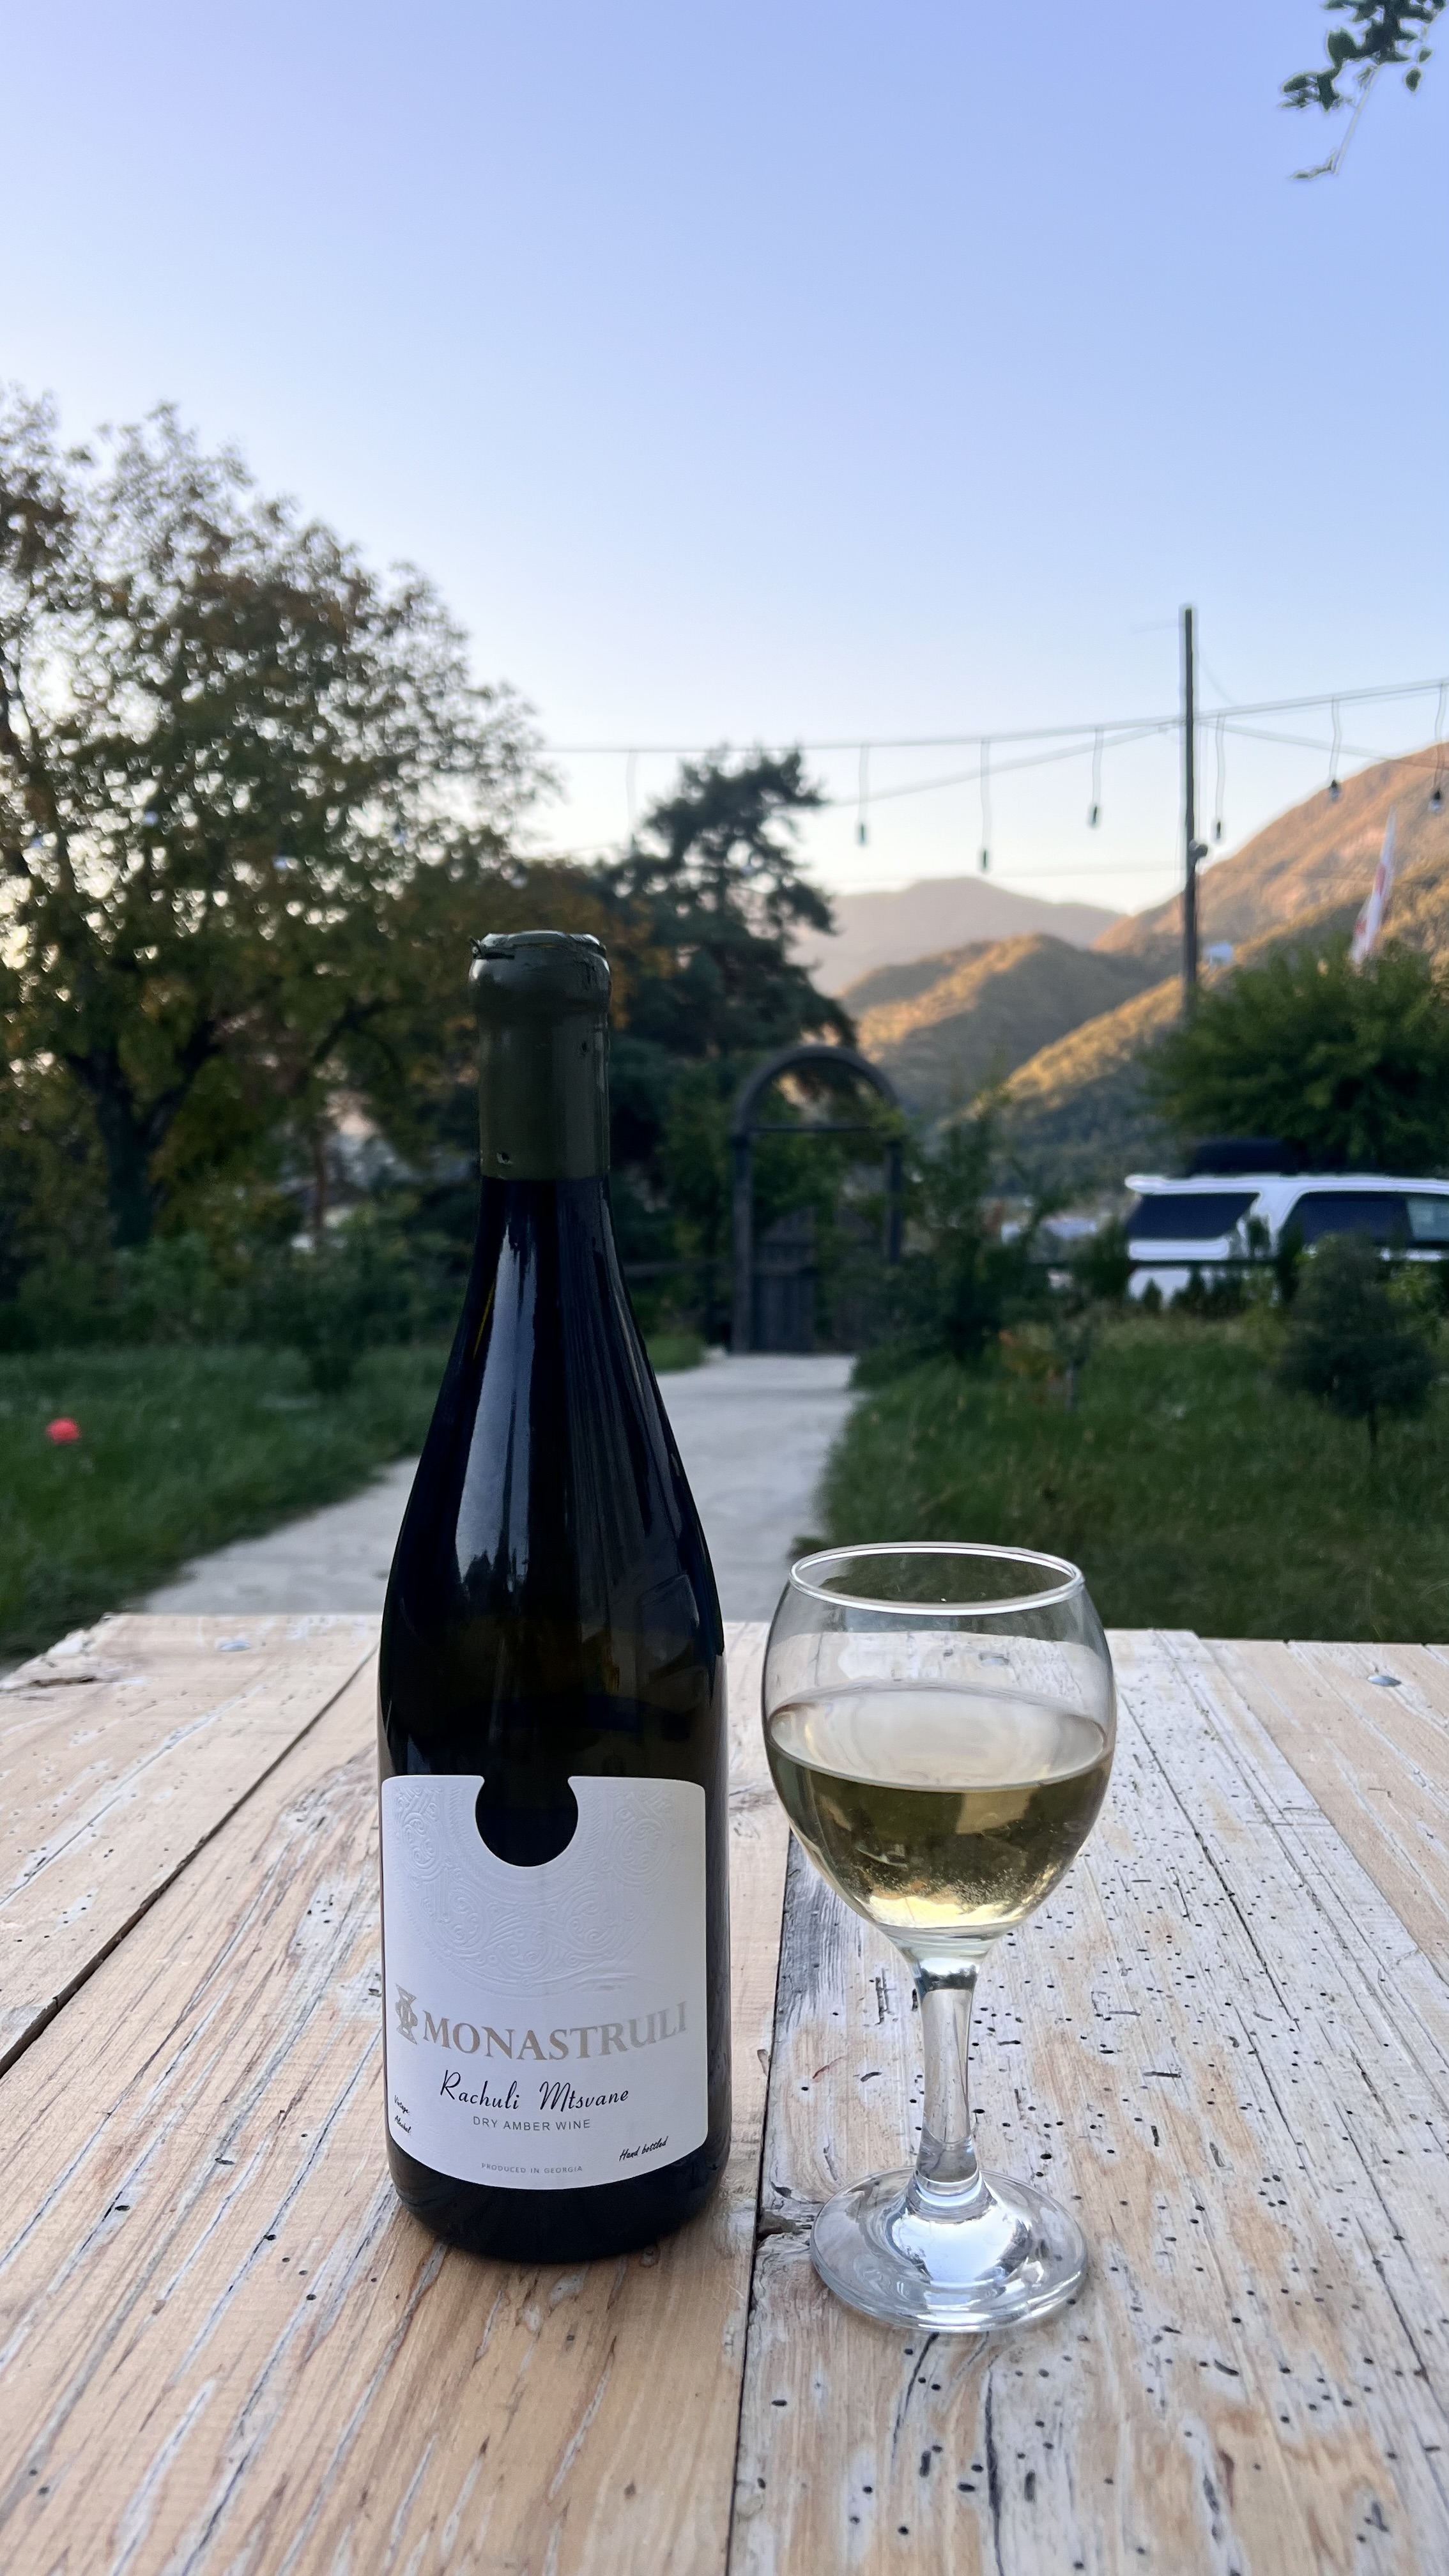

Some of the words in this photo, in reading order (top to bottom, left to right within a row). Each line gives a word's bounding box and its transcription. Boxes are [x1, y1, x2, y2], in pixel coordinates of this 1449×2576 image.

[422, 2000, 687, 2061] MONASTRULI
[440, 2069, 520, 2110] Rachuli
[539, 2081, 629, 2112] Mtsvane
[473, 2115, 498, 2128] DRY
[503, 2120, 551, 2131] AMBER
[555, 2118, 591, 2131] WINE
[618, 2145, 641, 2162] Hand
[641, 2135, 669, 2155] bottled
[481, 2162, 527, 2174] PRODUCED
[543, 2165, 583, 2174] GEORGIA
